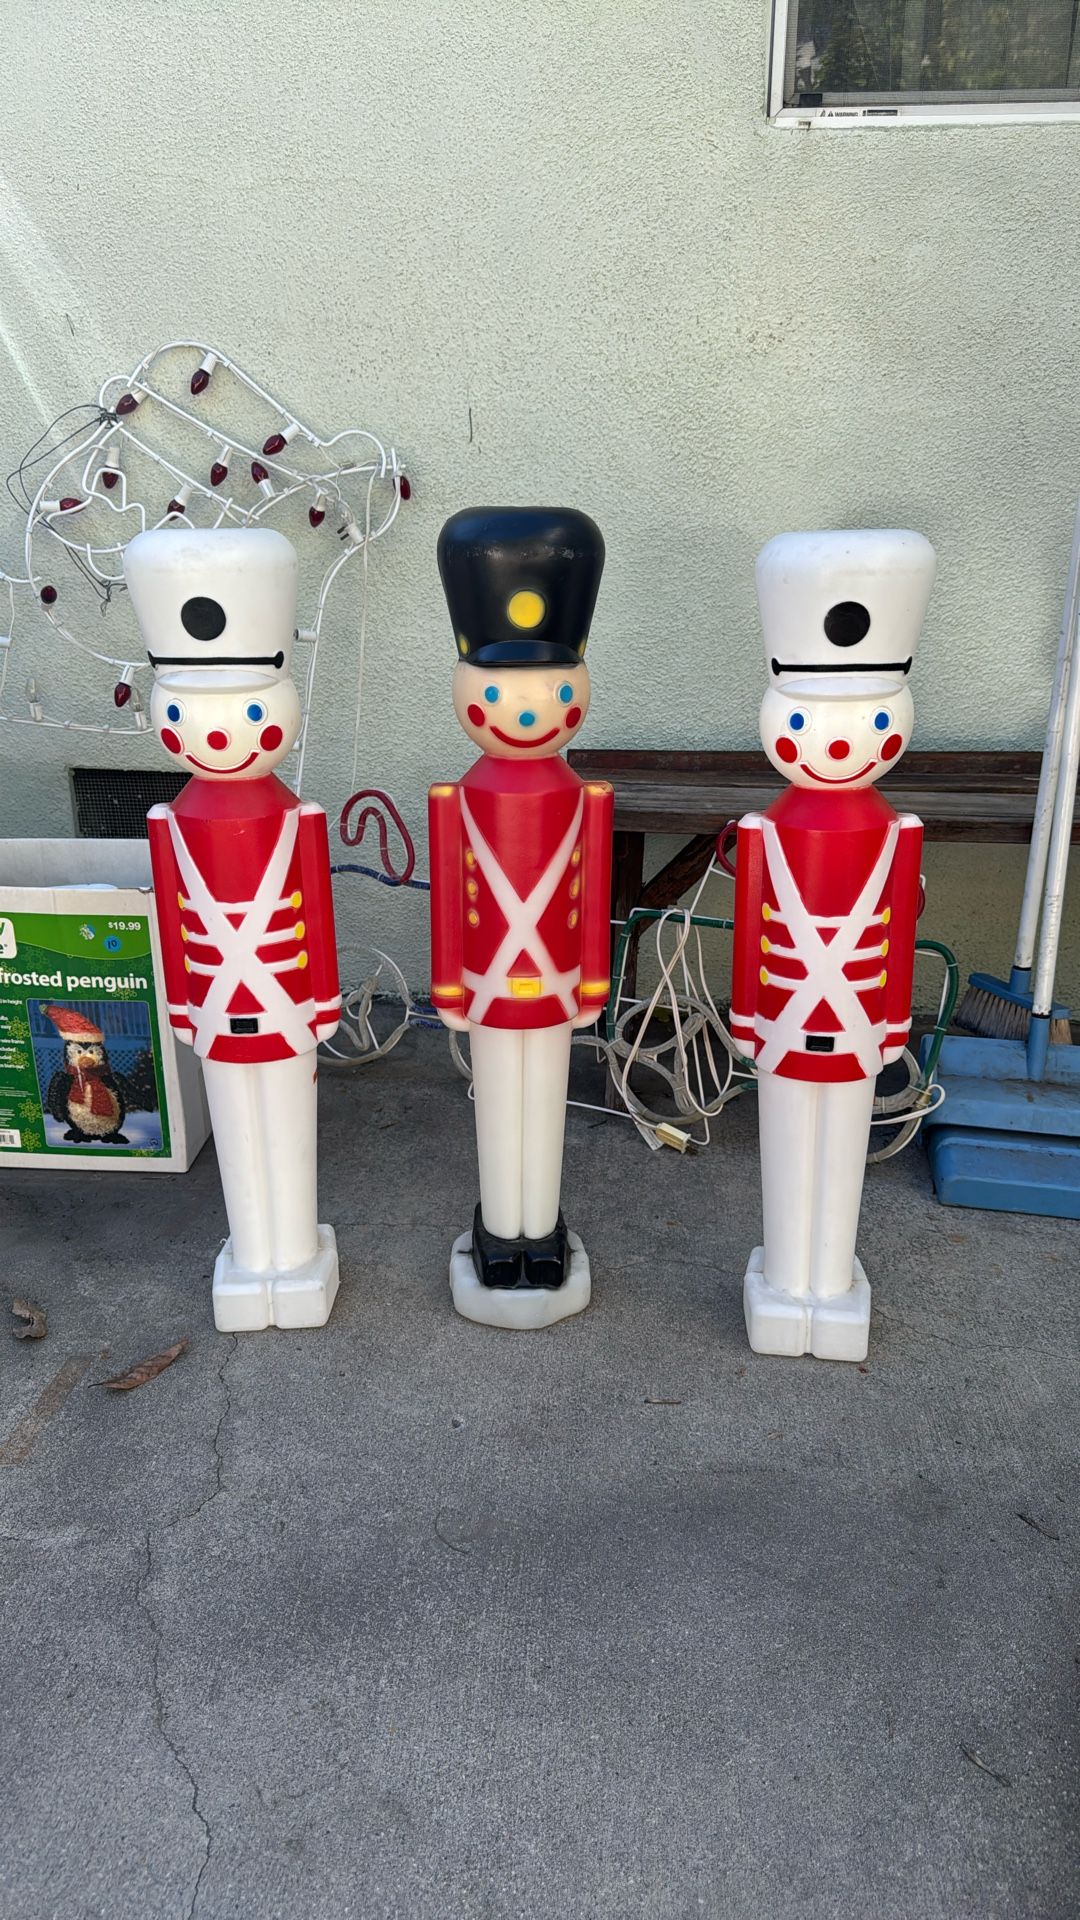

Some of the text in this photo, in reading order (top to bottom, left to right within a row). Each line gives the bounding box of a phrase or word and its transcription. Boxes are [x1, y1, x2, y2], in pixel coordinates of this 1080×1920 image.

[108, 921, 142, 931] $19.99
[0, 967, 148, 992] frosted penguin
